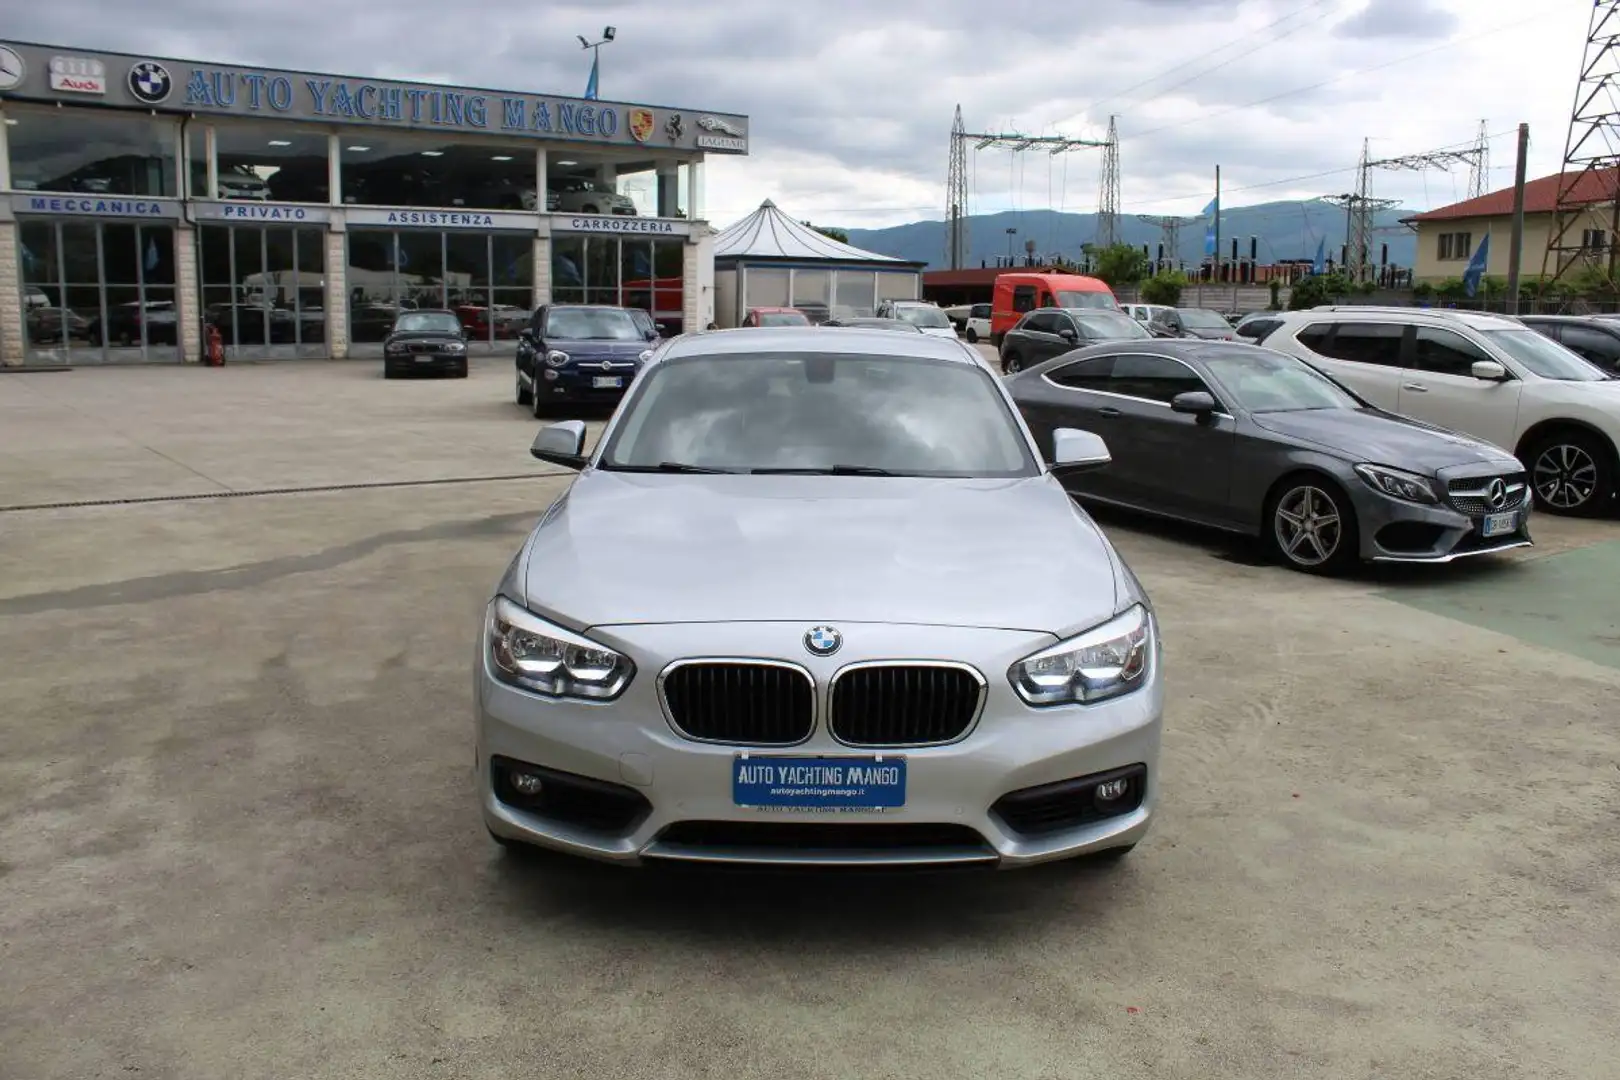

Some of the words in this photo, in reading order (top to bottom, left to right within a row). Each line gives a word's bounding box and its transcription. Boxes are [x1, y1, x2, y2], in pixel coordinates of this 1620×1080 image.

[60, 77, 99, 90] Audi
[184, 68, 292, 111] AUTO
[305, 78, 488, 127] YACHTING
[501, 98, 617, 137] MANGO
[31, 198, 160, 214] MECCANICA
[224, 205, 305, 219] PRIVATO
[388, 212, 492, 225] ASSISTENZA
[572, 219, 673, 233] CARROZZERIA
[738, 765, 774, 785] AUTO
[778, 766, 842, 785] YACHTING
[847, 766, 899, 785] MANGO
[770, 787, 865, 797] autoyachtingmango.it
